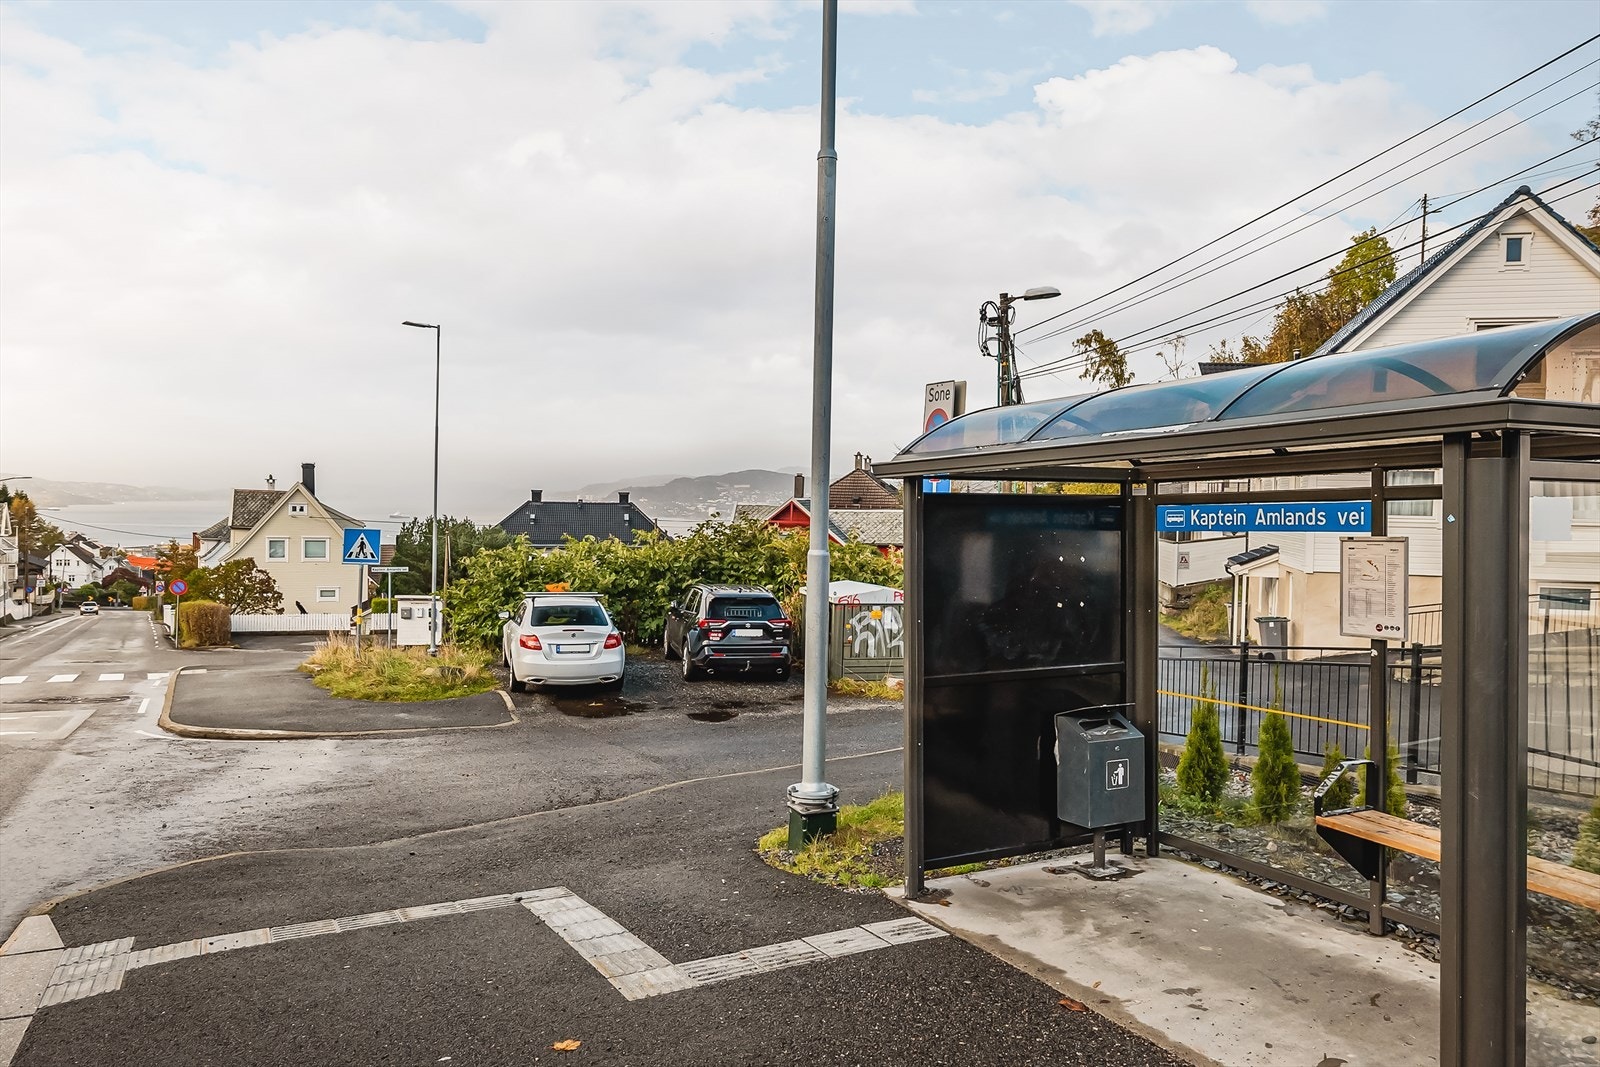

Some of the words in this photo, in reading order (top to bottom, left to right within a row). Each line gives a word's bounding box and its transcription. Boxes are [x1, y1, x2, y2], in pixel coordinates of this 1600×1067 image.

[928, 387, 951, 402] Sone
[1190, 508, 1246, 529] Kaptein
[1255, 507, 1327, 526] Amlands
[1337, 506, 1365, 525] vei
